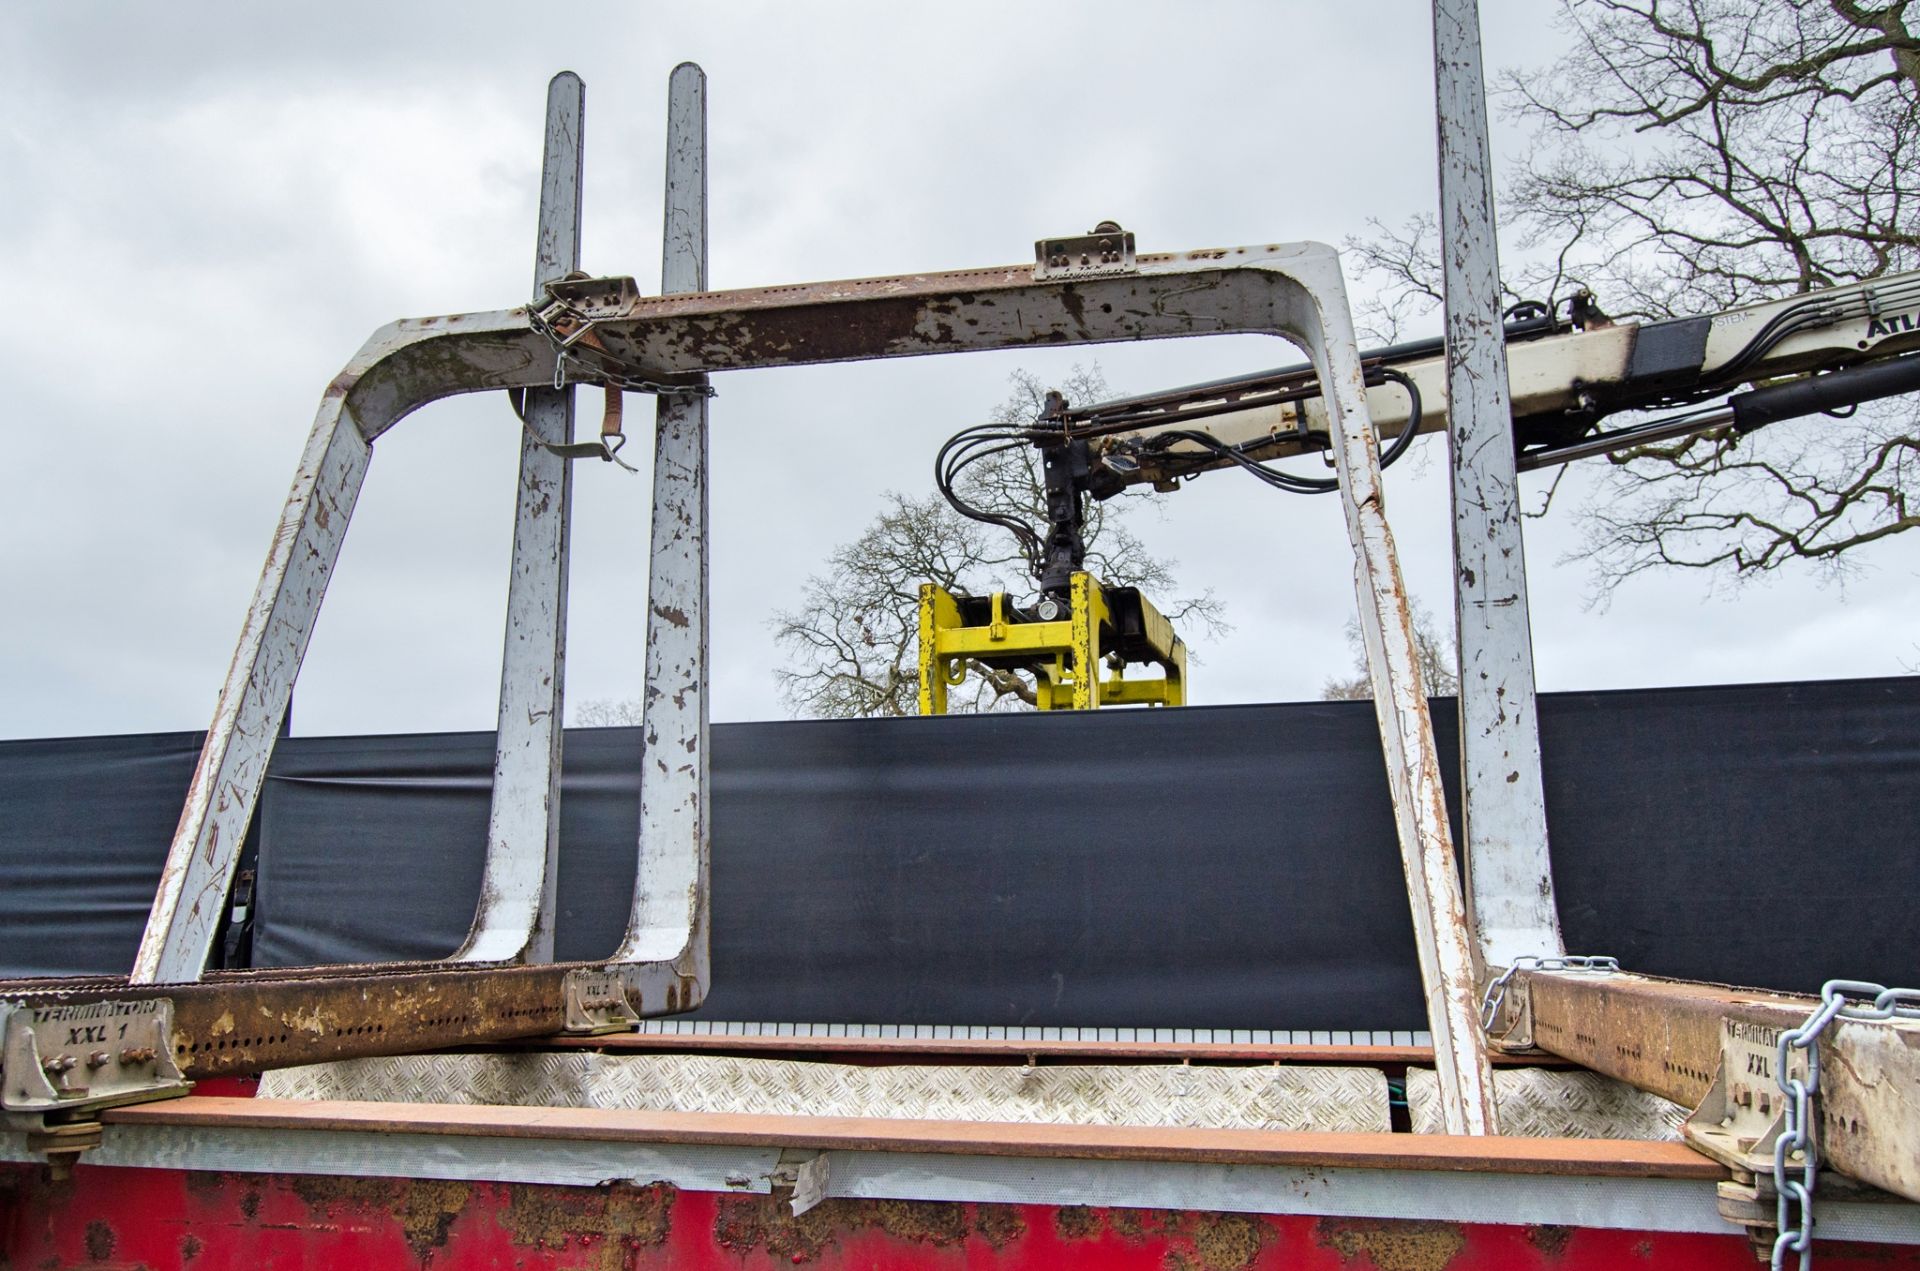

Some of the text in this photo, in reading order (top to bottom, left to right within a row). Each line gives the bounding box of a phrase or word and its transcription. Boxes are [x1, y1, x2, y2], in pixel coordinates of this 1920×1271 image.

[1867, 311, 1920, 339] ATL
[64, 1023, 129, 1046] XXL 1
[1747, 1052, 1770, 1079] XXL
